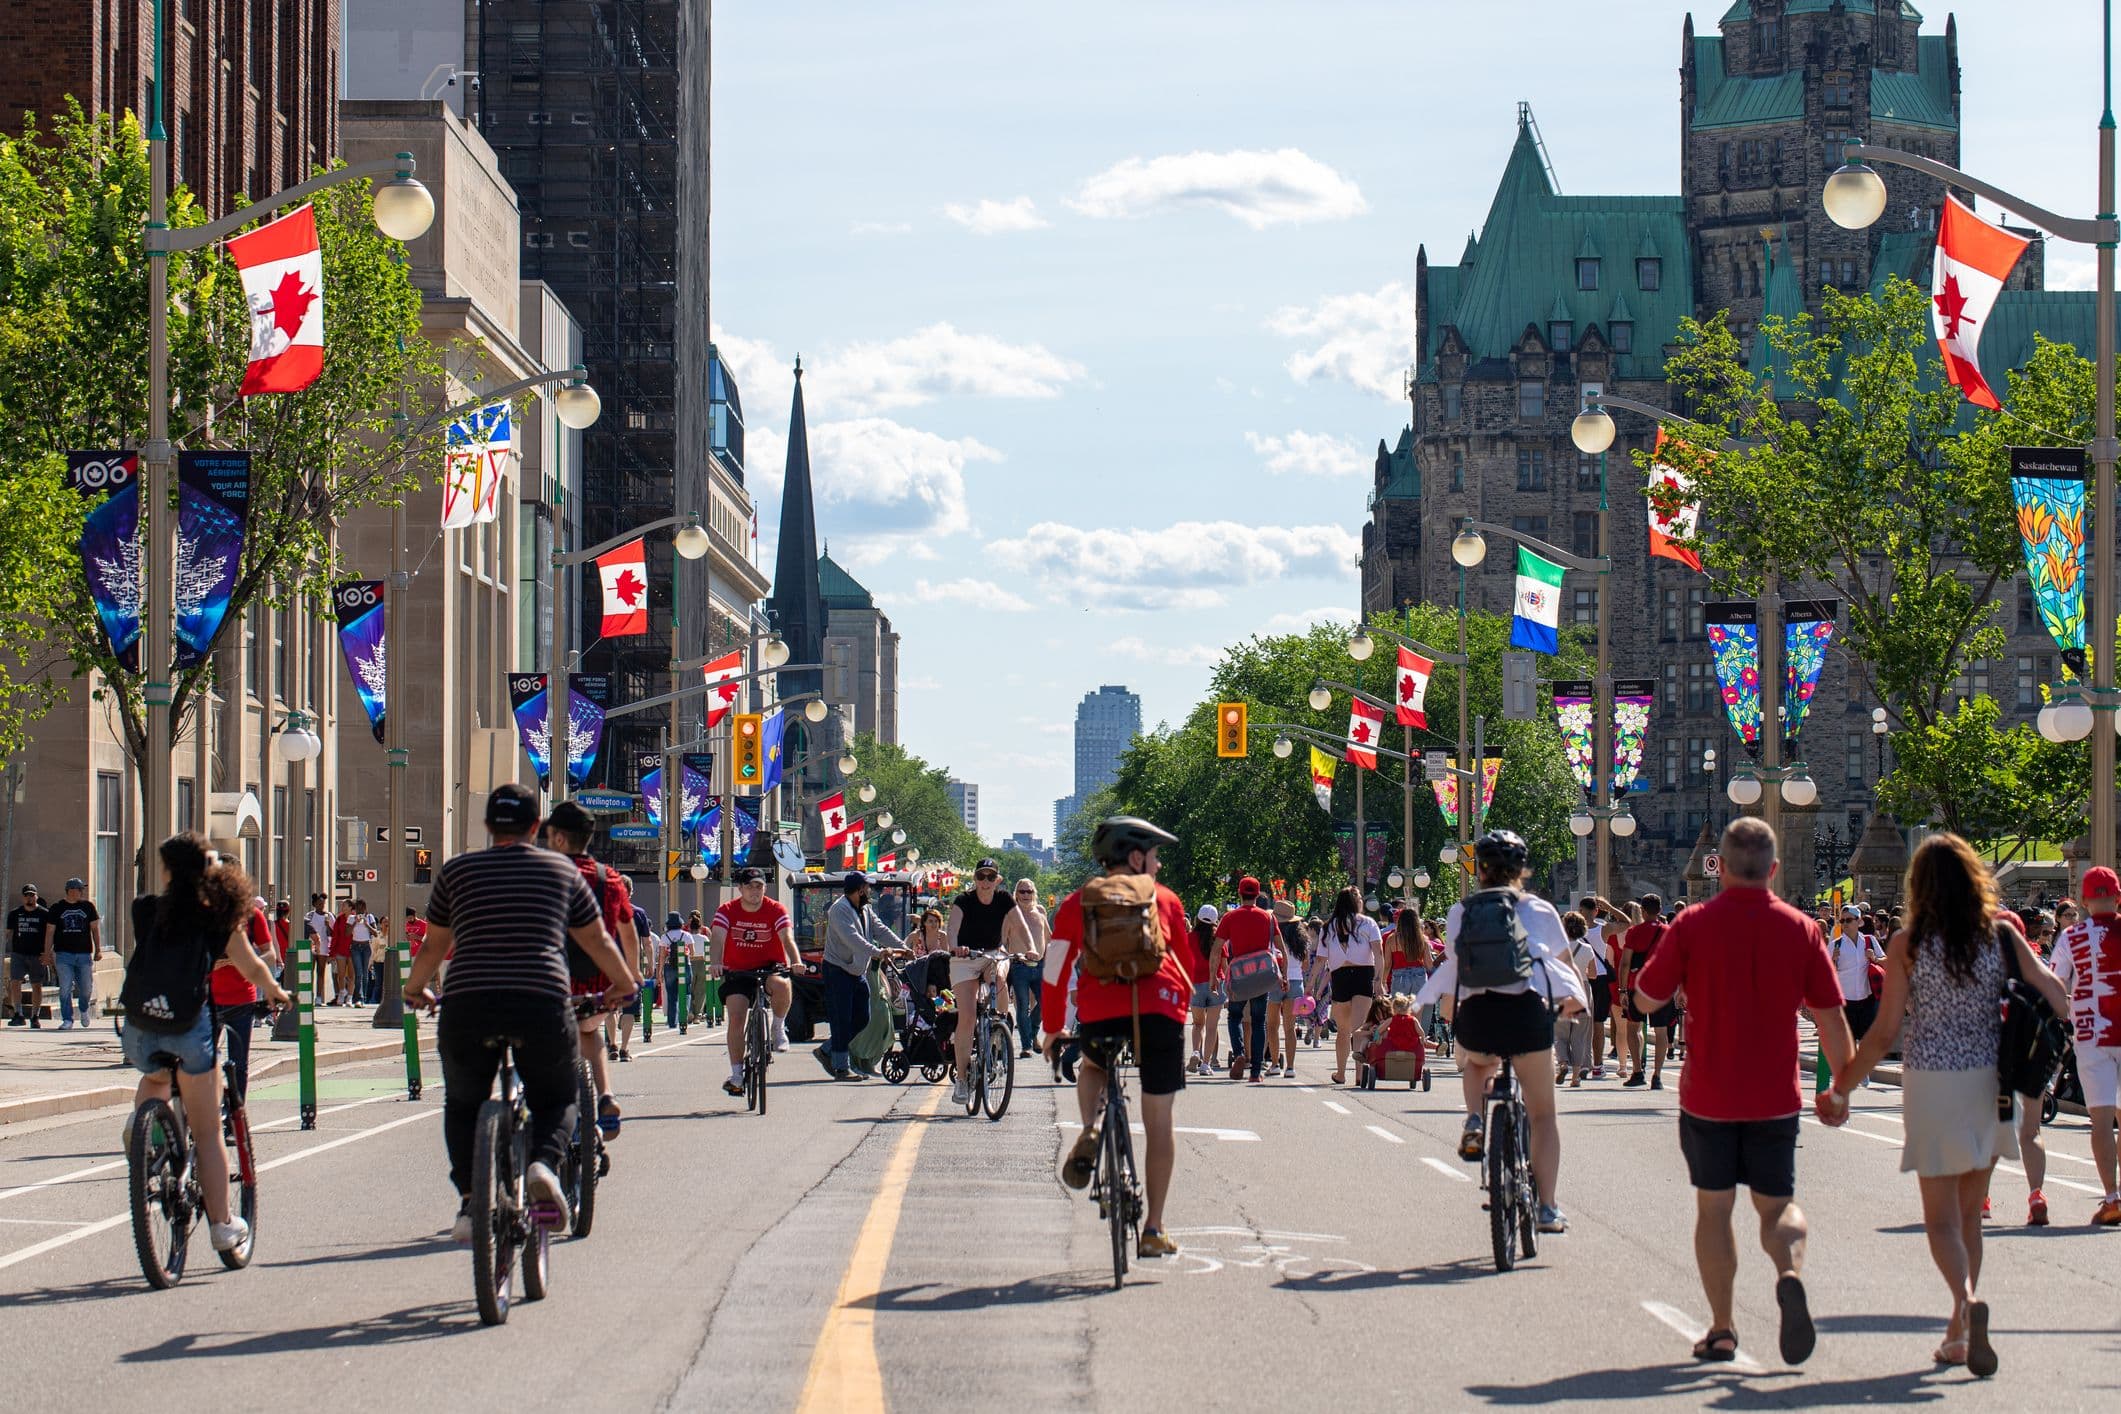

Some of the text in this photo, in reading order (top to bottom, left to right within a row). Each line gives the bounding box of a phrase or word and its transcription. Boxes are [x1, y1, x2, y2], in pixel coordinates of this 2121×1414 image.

[194, 459, 248, 467] VOTRE FORCE
[2018, 461, 2078, 472] Saskatchewan
[211, 481, 247, 490] YOUR AIR
[586, 797, 620, 807] Wellington
[2066, 922, 2094, 1001] CANADA
[2074, 1006, 2095, 1042] 150
